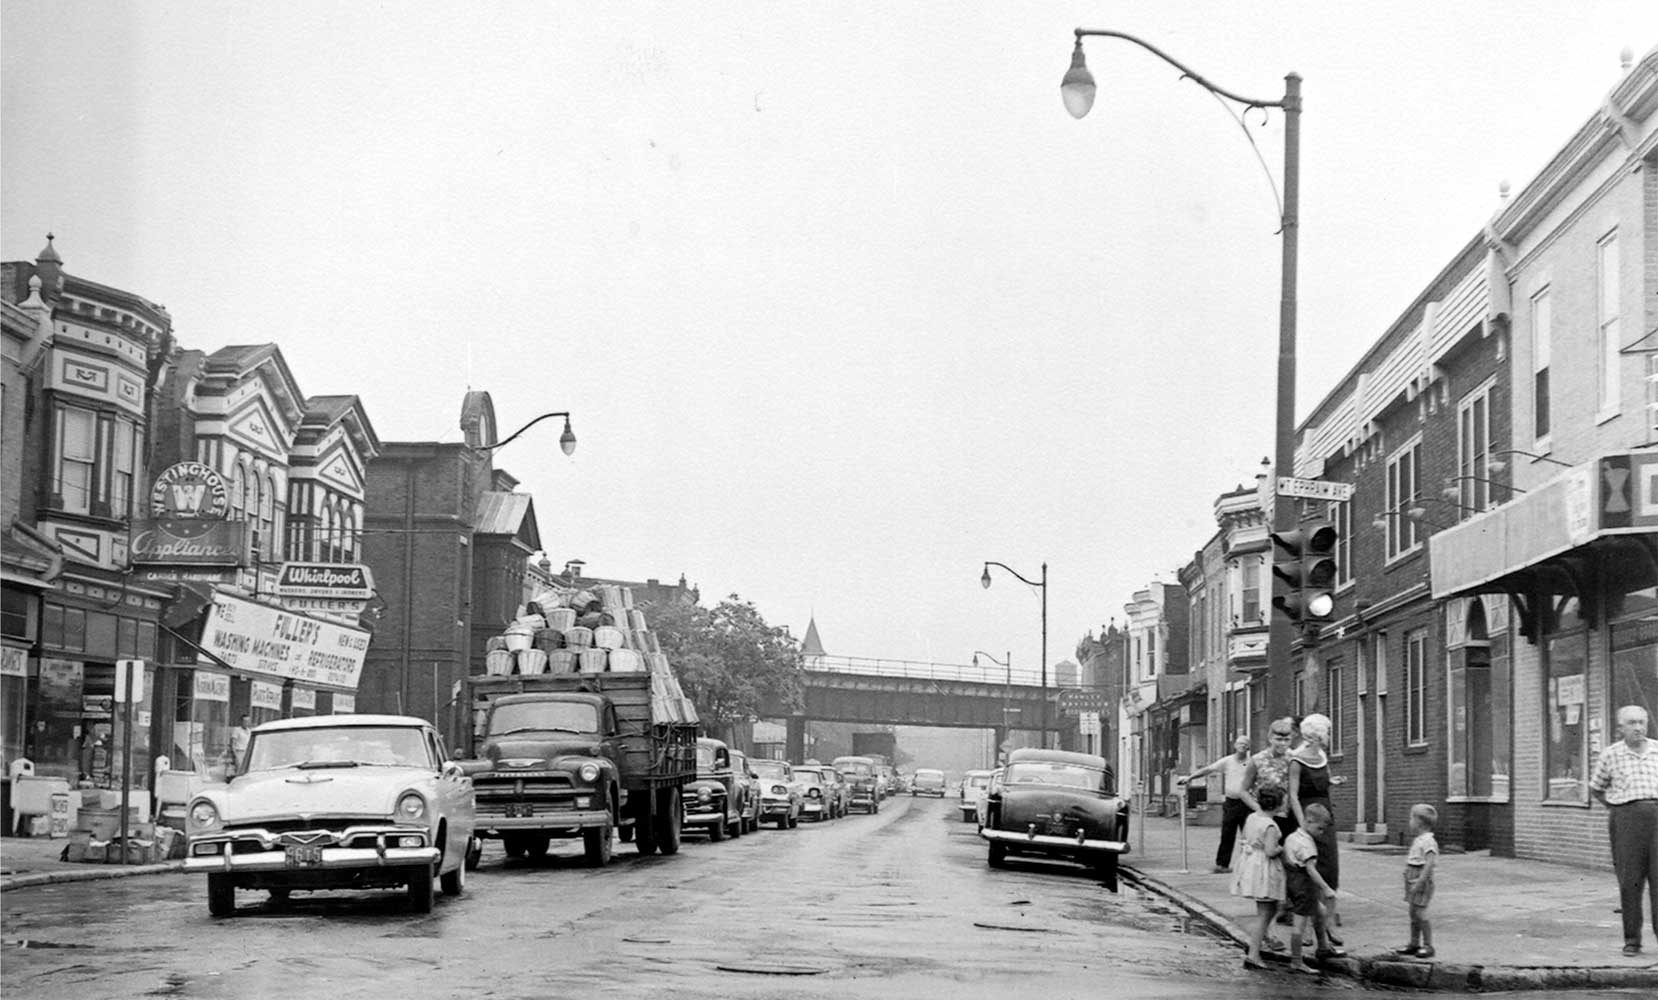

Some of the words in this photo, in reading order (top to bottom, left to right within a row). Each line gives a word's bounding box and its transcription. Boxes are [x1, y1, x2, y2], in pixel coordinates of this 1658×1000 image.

[152, 464, 226, 517] WESTINGHOUSE
[172, 484, 206, 511] W
[1293, 480, 1330, 496] EPHRAIM
[1331, 484, 1349, 499] AVE
[288, 567, 360, 587] Whirlpool
[288, 600, 360, 611] FULLER'S
[273, 613, 321, 646] FULLER'S
[214, 629, 251, 654] WASHING
[252, 639, 291, 661] MACHINES
